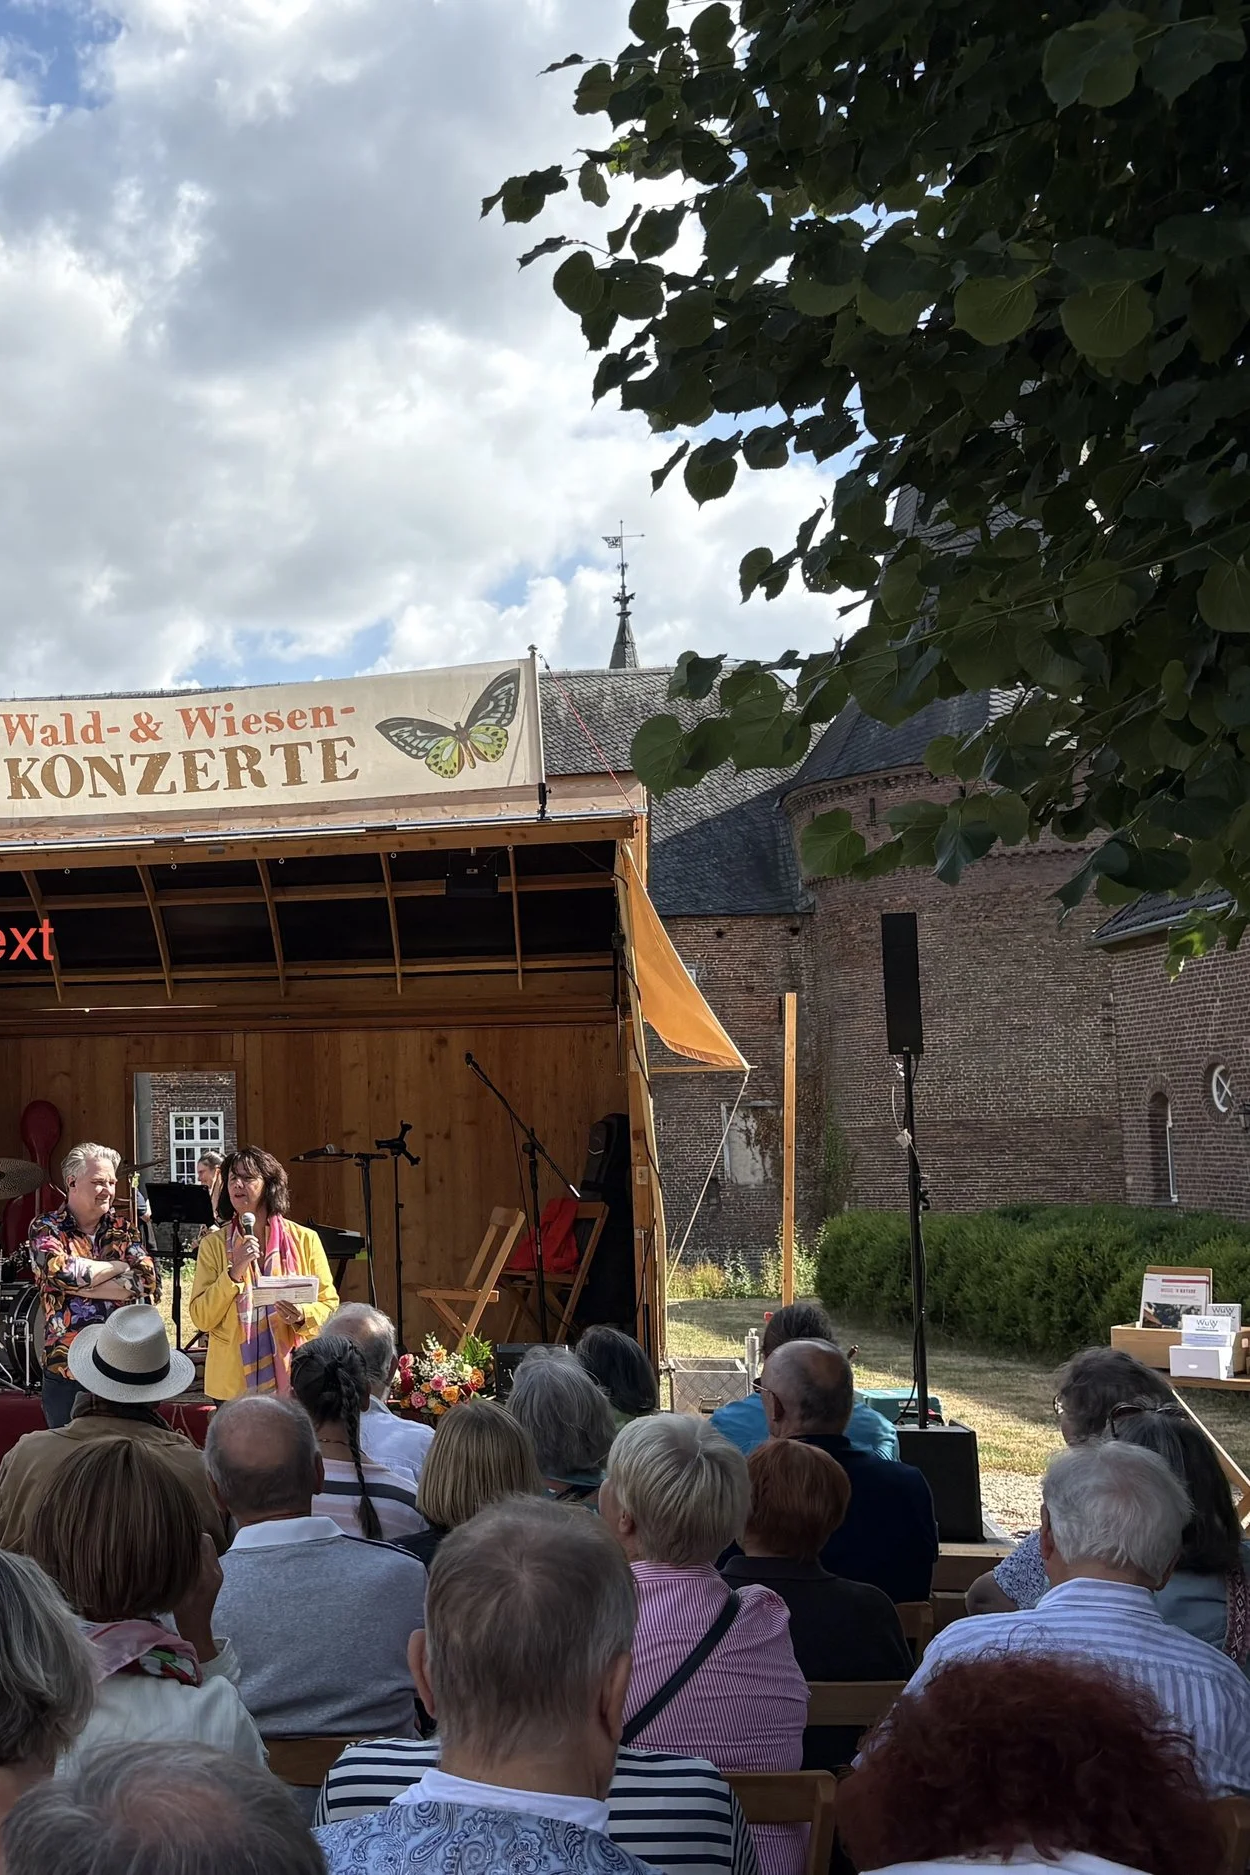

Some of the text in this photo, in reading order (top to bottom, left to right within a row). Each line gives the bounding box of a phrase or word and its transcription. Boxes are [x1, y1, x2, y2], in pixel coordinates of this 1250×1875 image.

[129, 711, 163, 743] &
[175, 702, 356, 740] Wiesen-
[3, 736, 359, 799] KONZERTE
